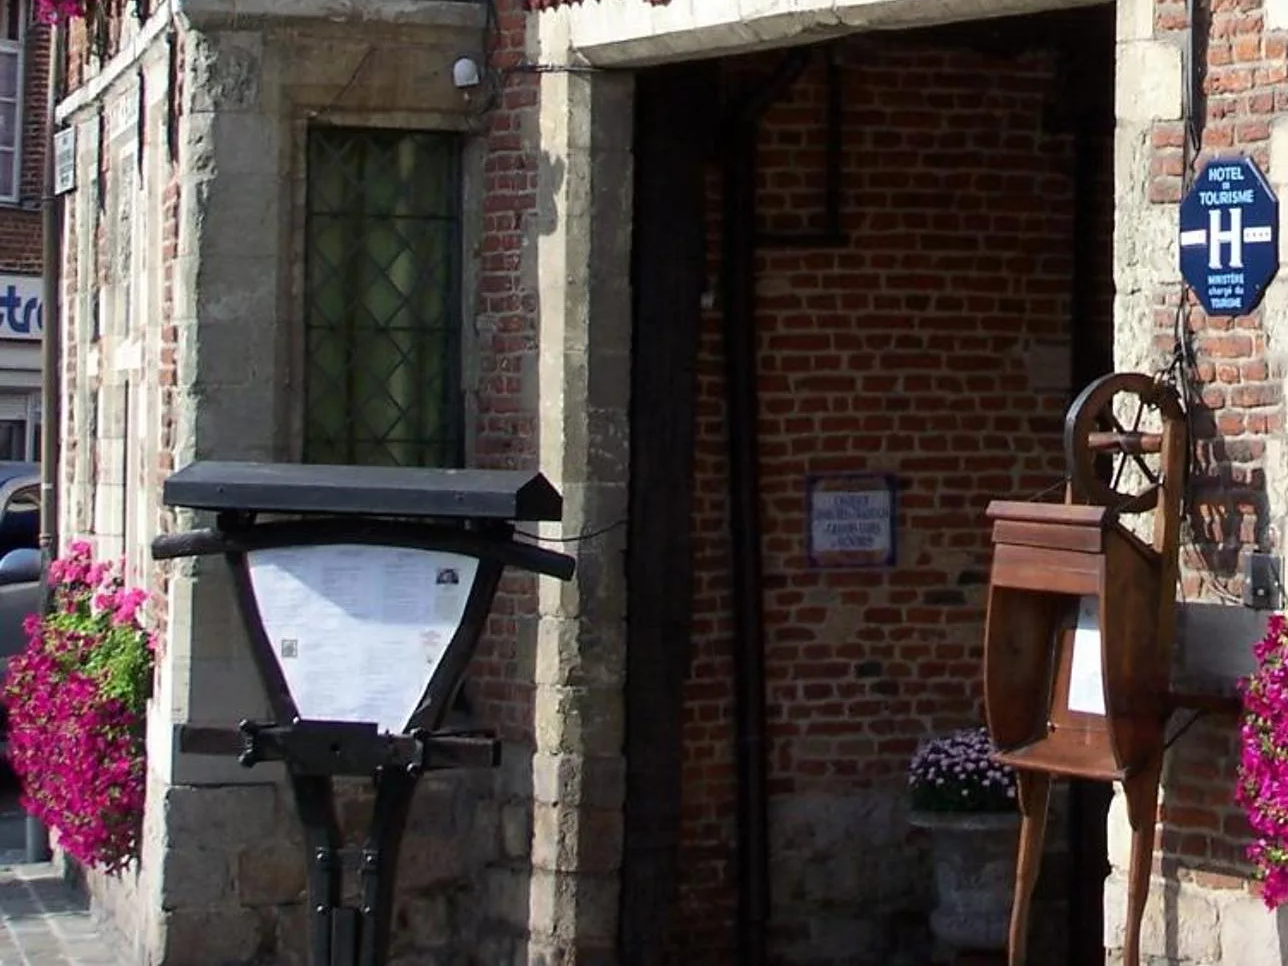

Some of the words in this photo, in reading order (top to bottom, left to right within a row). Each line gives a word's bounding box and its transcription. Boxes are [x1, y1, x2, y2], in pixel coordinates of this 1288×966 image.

[1208, 166, 1245, 182] HOTEL
[1199, 189, 1255, 206] TOURISME
[1208, 207, 1244, 270] H
